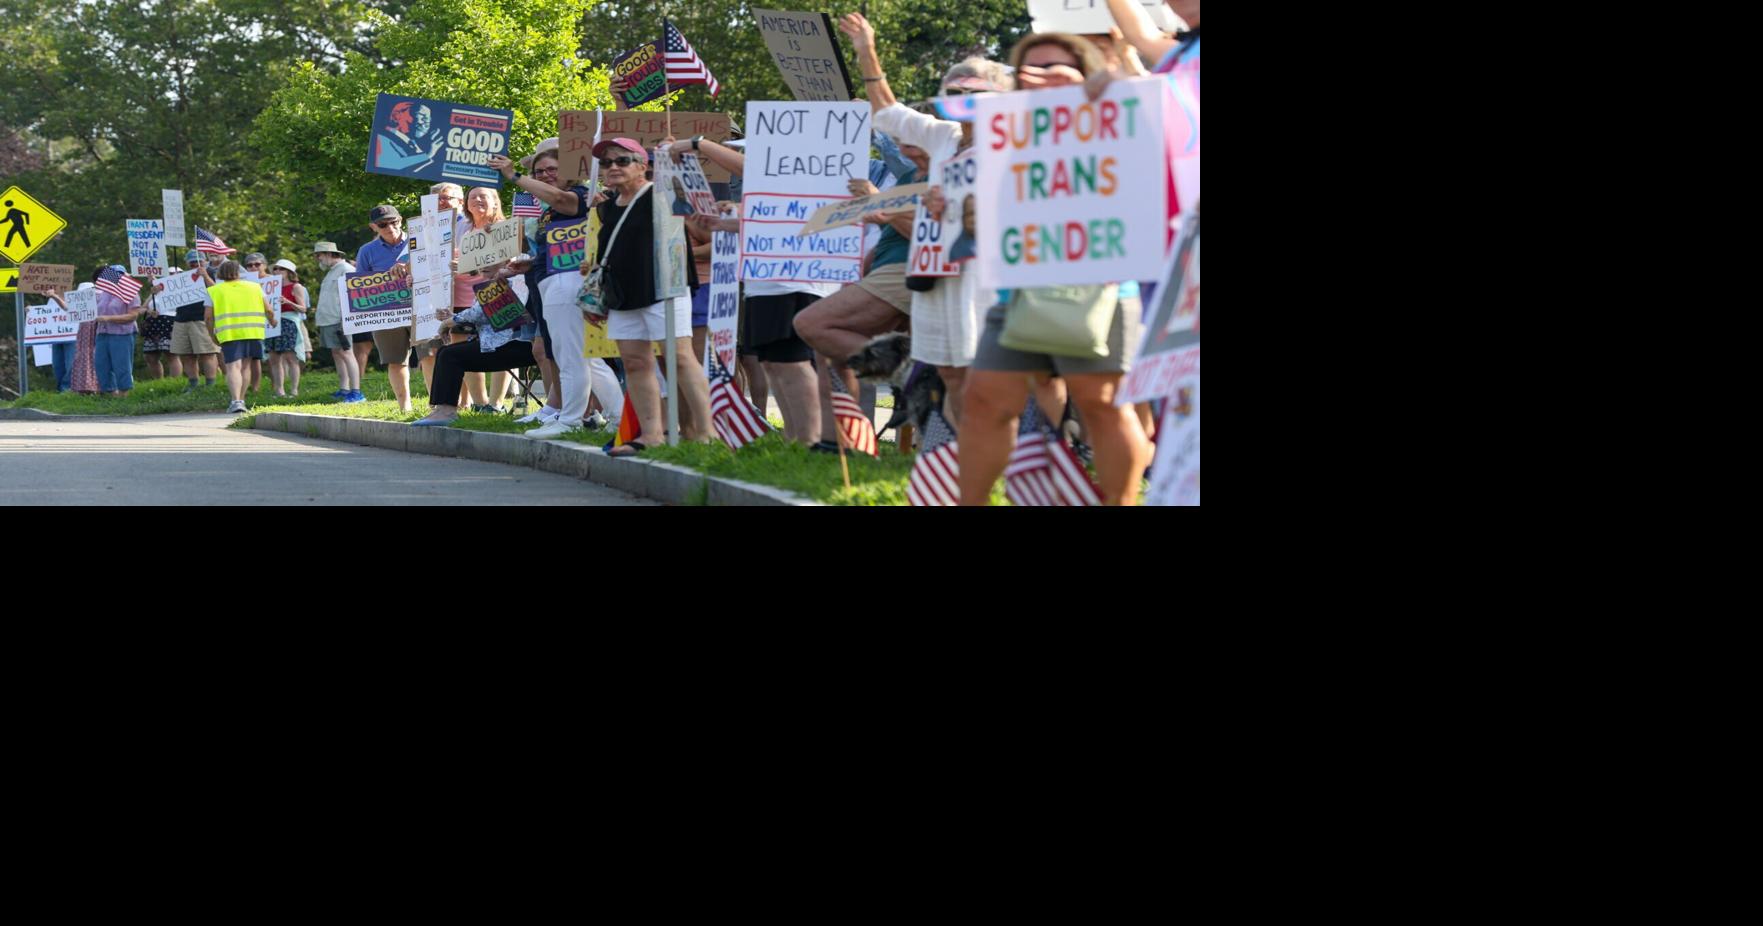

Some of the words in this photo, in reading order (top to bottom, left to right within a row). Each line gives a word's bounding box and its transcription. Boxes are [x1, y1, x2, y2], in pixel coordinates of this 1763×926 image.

[761, 15, 821, 37] AMERICA
[617, 48, 650, 77] Good
[776, 52, 836, 74] BETTER
[627, 75, 664, 100] Lives
[794, 74, 833, 92] THAN
[636, 118, 680, 134] LIKE
[686, 119, 728, 134] THIS
[755, 109, 810, 136] NOT
[824, 109, 869, 145] MY
[990, 97, 1140, 151] SUPPORT
[447, 128, 505, 153] GOOD
[445, 149, 495, 167] TROUBL
[764, 146, 855, 180] LEADER
[682, 173, 708, 191] OUR
[944, 158, 978, 188] PRO
[1010, 155, 1119, 203] TRANS
[152, 221, 159, 229] A
[552, 224, 588, 242] Goo
[128, 231, 164, 240] PRESIDENT
[462, 232, 486, 255] GOOD
[746, 235, 776, 252] NOT
[782, 234, 804, 252] MY
[809, 233, 861, 254] VALUES
[1002, 218, 1126, 265] GENDER
[131, 249, 158, 259] SENILE
[132, 241, 149, 249] NOT
[153, 241, 159, 250] A
[138, 257, 156, 266] OLD
[475, 253, 496, 267] LIVES
[28, 265, 49, 274] HATE
[138, 266, 163, 275] BIGOT
[742, 258, 778, 278] NOT
[780, 259, 804, 281] MY
[167, 274, 193, 292] DUE
[351, 272, 393, 288] Good
[355, 279, 407, 298] Trouble
[161, 286, 208, 308] PROCESS
[356, 292, 397, 308] Lives
[398, 288, 411, 300] O
[478, 282, 505, 304] Good
[27, 317, 47, 325] GOOD
[52, 315, 67, 323] TRO
[69, 309, 95, 322] TRUTH!
[354, 319, 387, 328] WITHOUT
[388, 316, 402, 324] DUE
[403, 314, 412, 322] PR
[356, 311, 396, 321] DEPORTING
[397, 309, 412, 317] IMM
